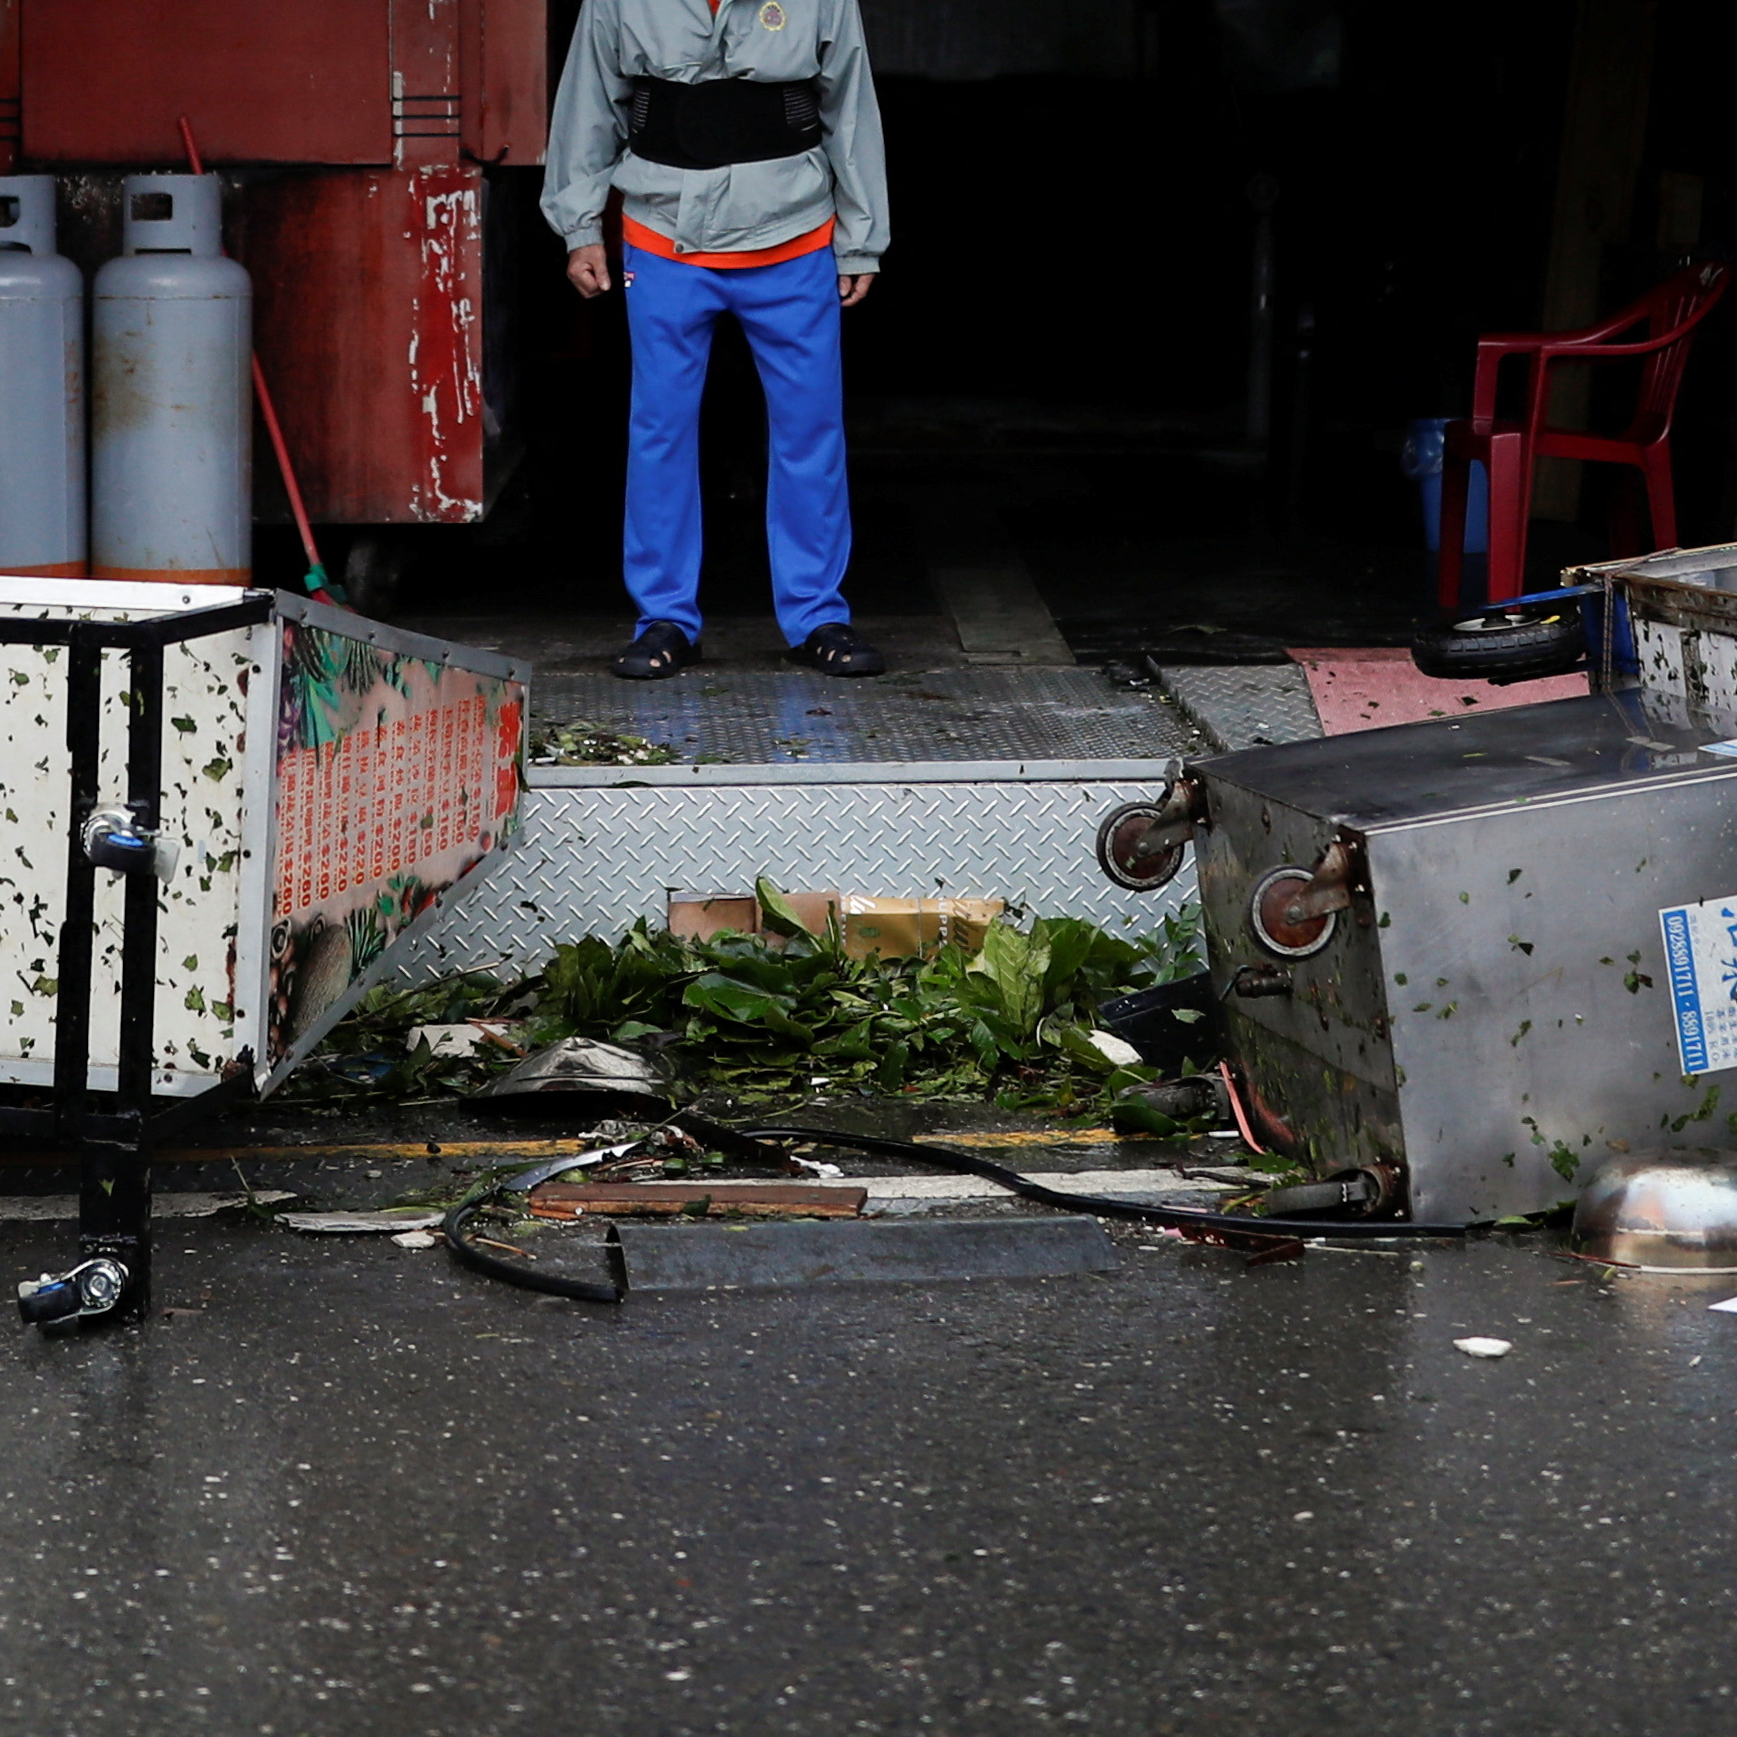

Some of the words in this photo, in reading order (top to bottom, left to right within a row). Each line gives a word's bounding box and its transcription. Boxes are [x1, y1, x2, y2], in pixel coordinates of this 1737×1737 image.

[338, 837, 348, 891] $220
[355, 831, 366, 884] $220
[374, 824, 384, 878] $200
[391, 817, 402, 871] $200
[283, 858, 293, 914] $260
[301, 851, 312, 906] $260
